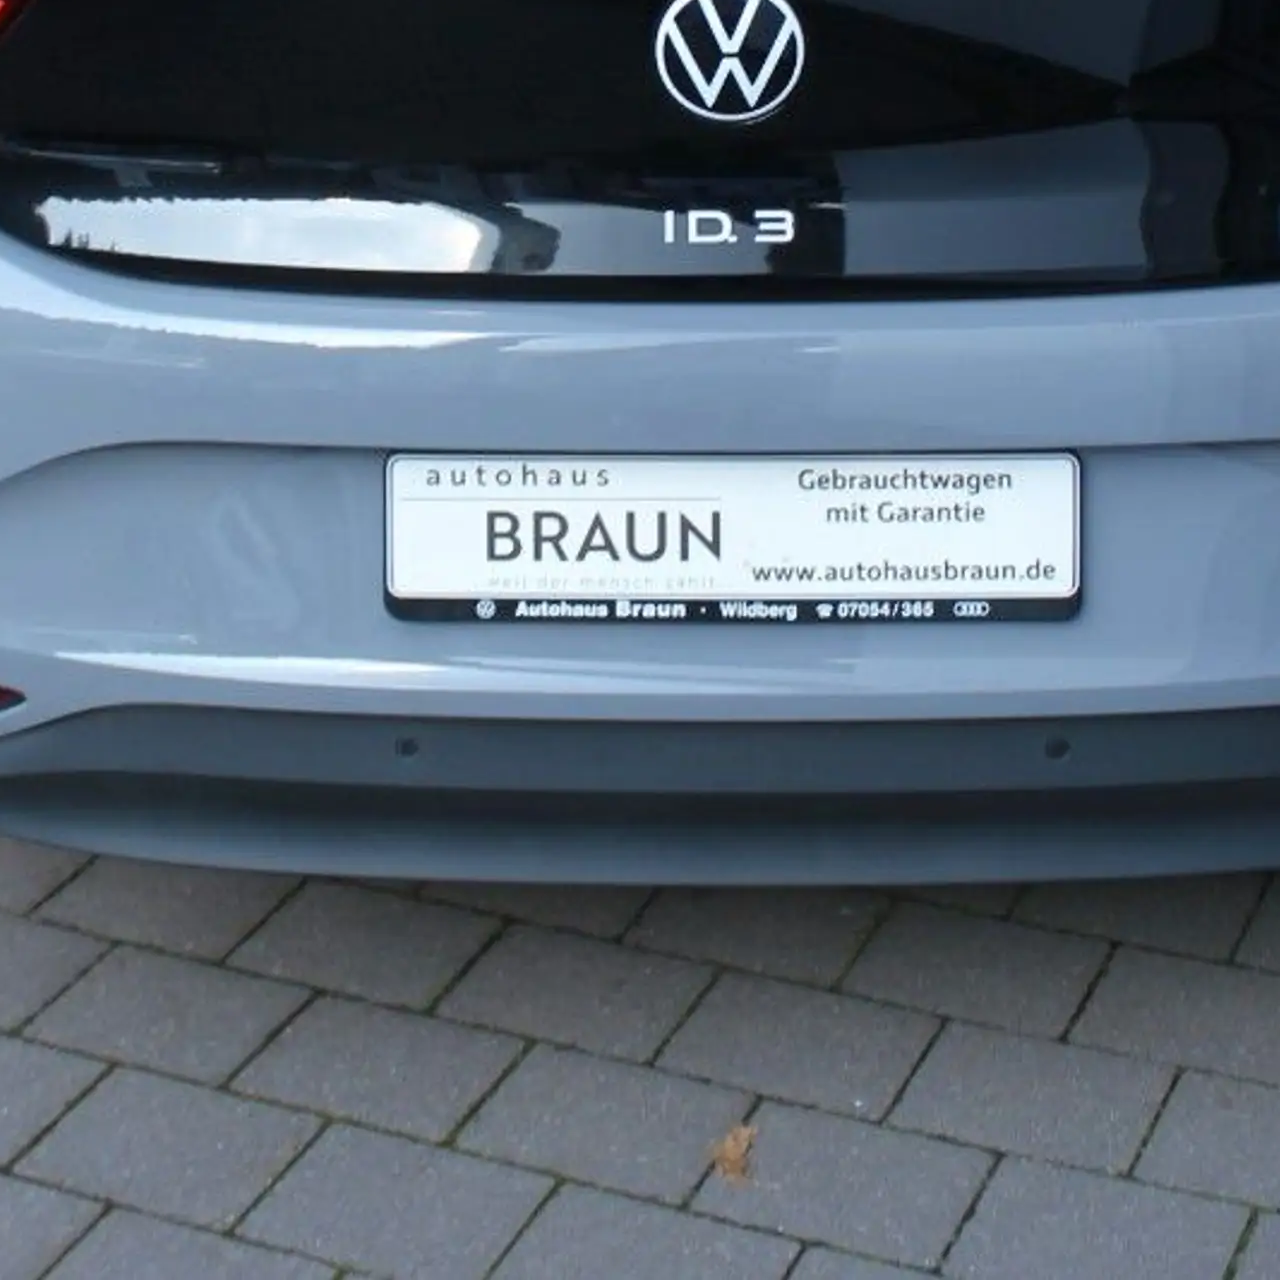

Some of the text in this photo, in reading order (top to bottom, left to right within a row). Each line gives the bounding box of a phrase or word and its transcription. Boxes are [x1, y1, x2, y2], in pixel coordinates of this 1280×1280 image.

[426, 464, 611, 487] autohaus
[798, 468, 1013, 495] Gebrauchtwagen
[825, 502, 986, 523] mit Garantie
[486, 510, 722, 562] BRAUN
[752, 558, 1057, 583] www.autohausbraun.de
[515, 601, 608, 619] Autohaus
[615, 600, 687, 619] Braun
[720, 601, 797, 620] Wildberg
